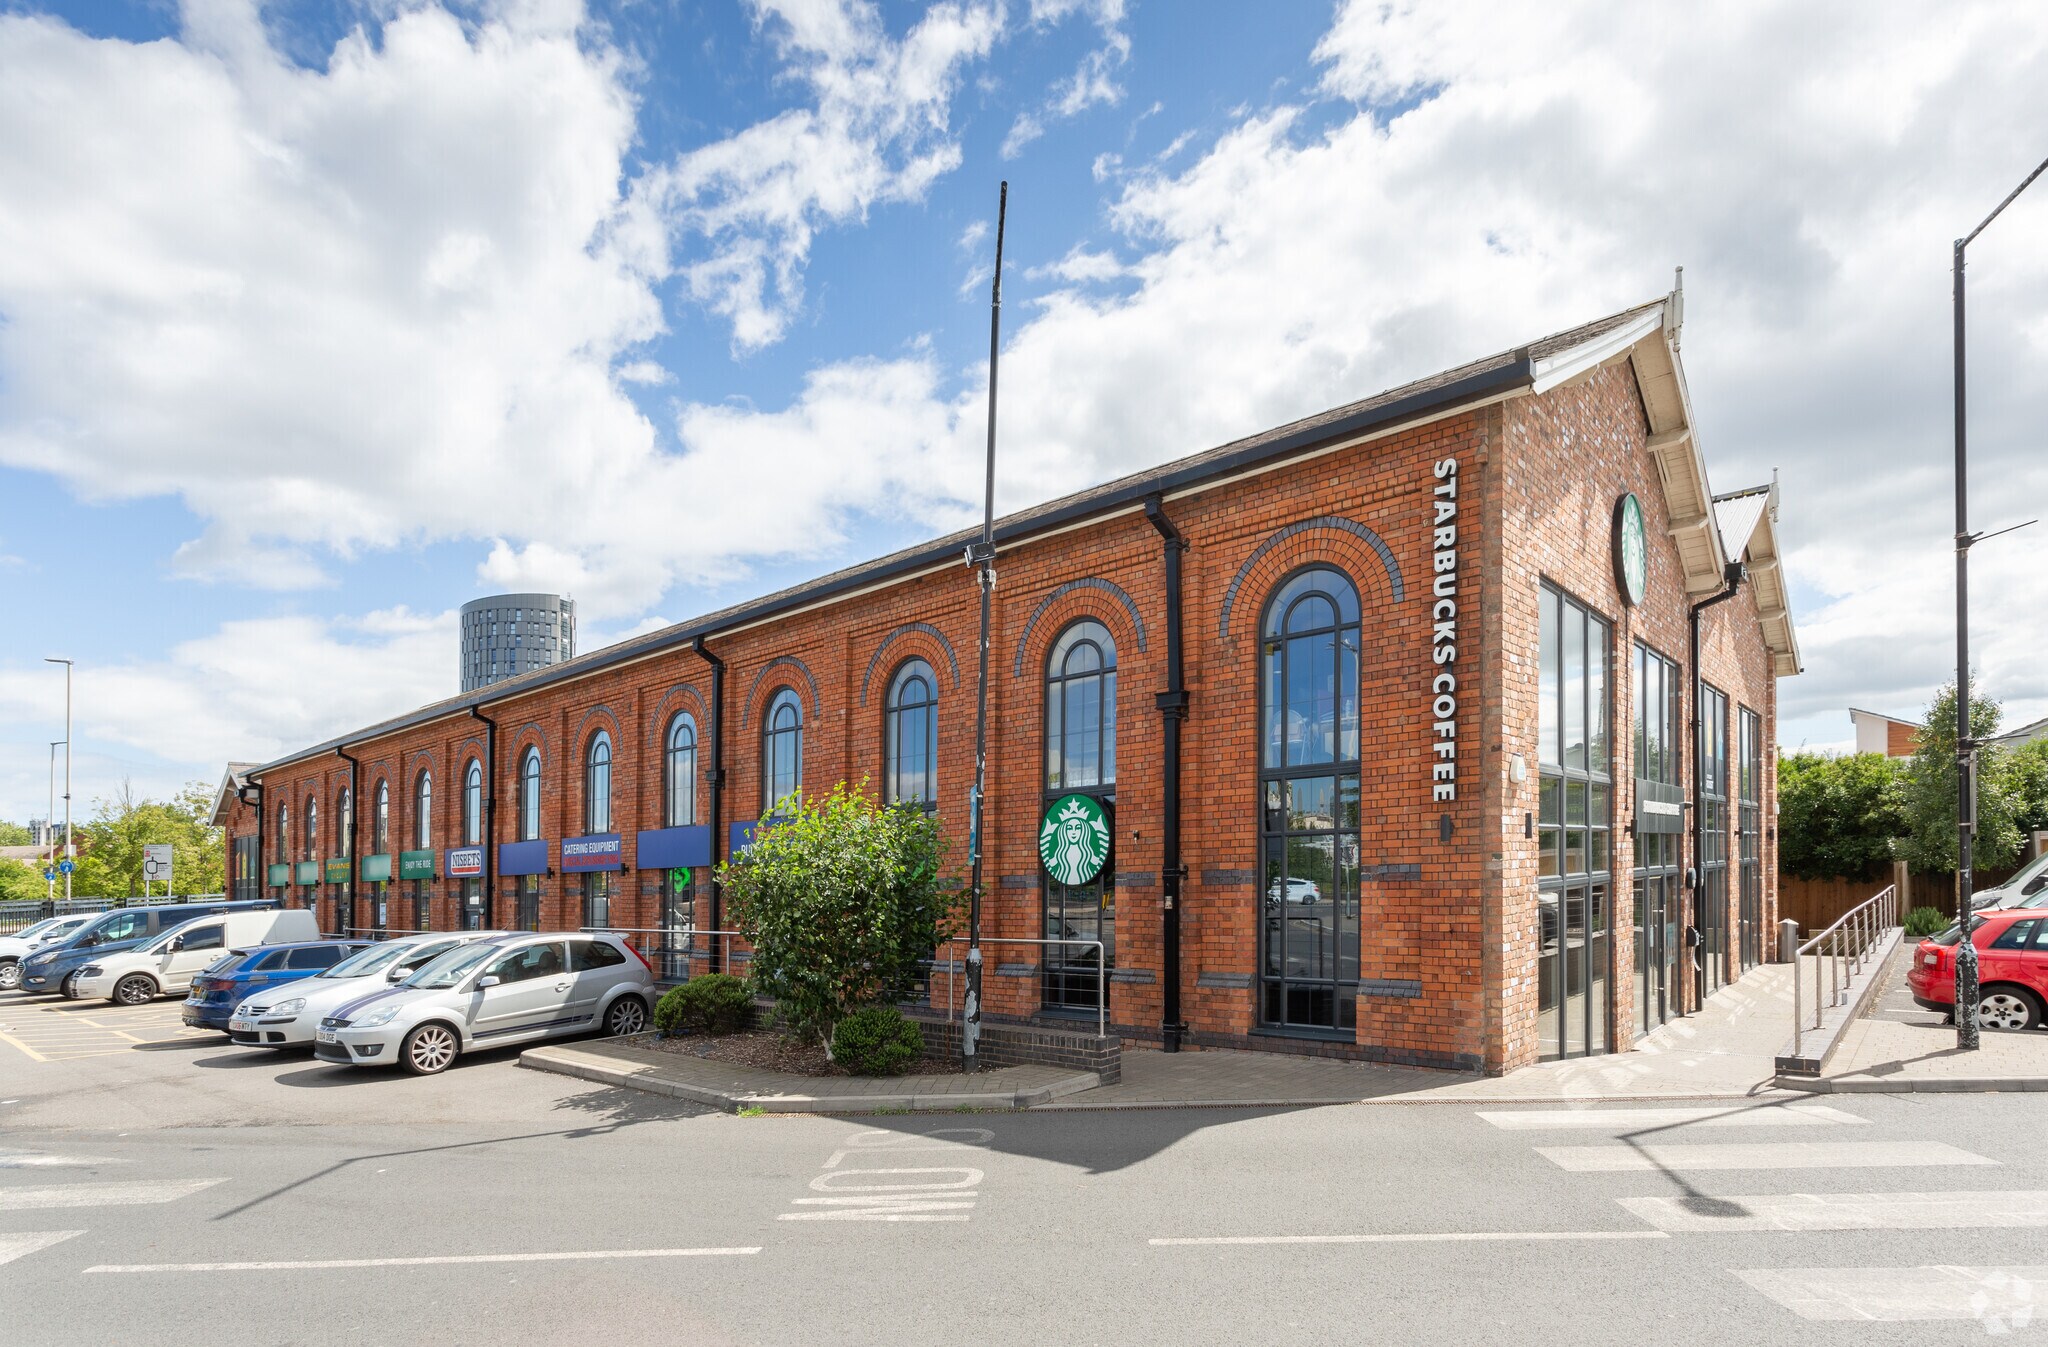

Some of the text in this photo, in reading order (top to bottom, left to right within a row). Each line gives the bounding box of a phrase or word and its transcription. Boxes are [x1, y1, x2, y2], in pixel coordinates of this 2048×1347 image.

[1433, 458, 1457, 802] STARBUCKS COFFEE
[564, 840, 619, 855] CATERING EQUIPMENT
[423, 860, 431, 868] RIDE
[452, 853, 480, 867] NISBETS
[777, 1127, 996, 1221] SLOW
